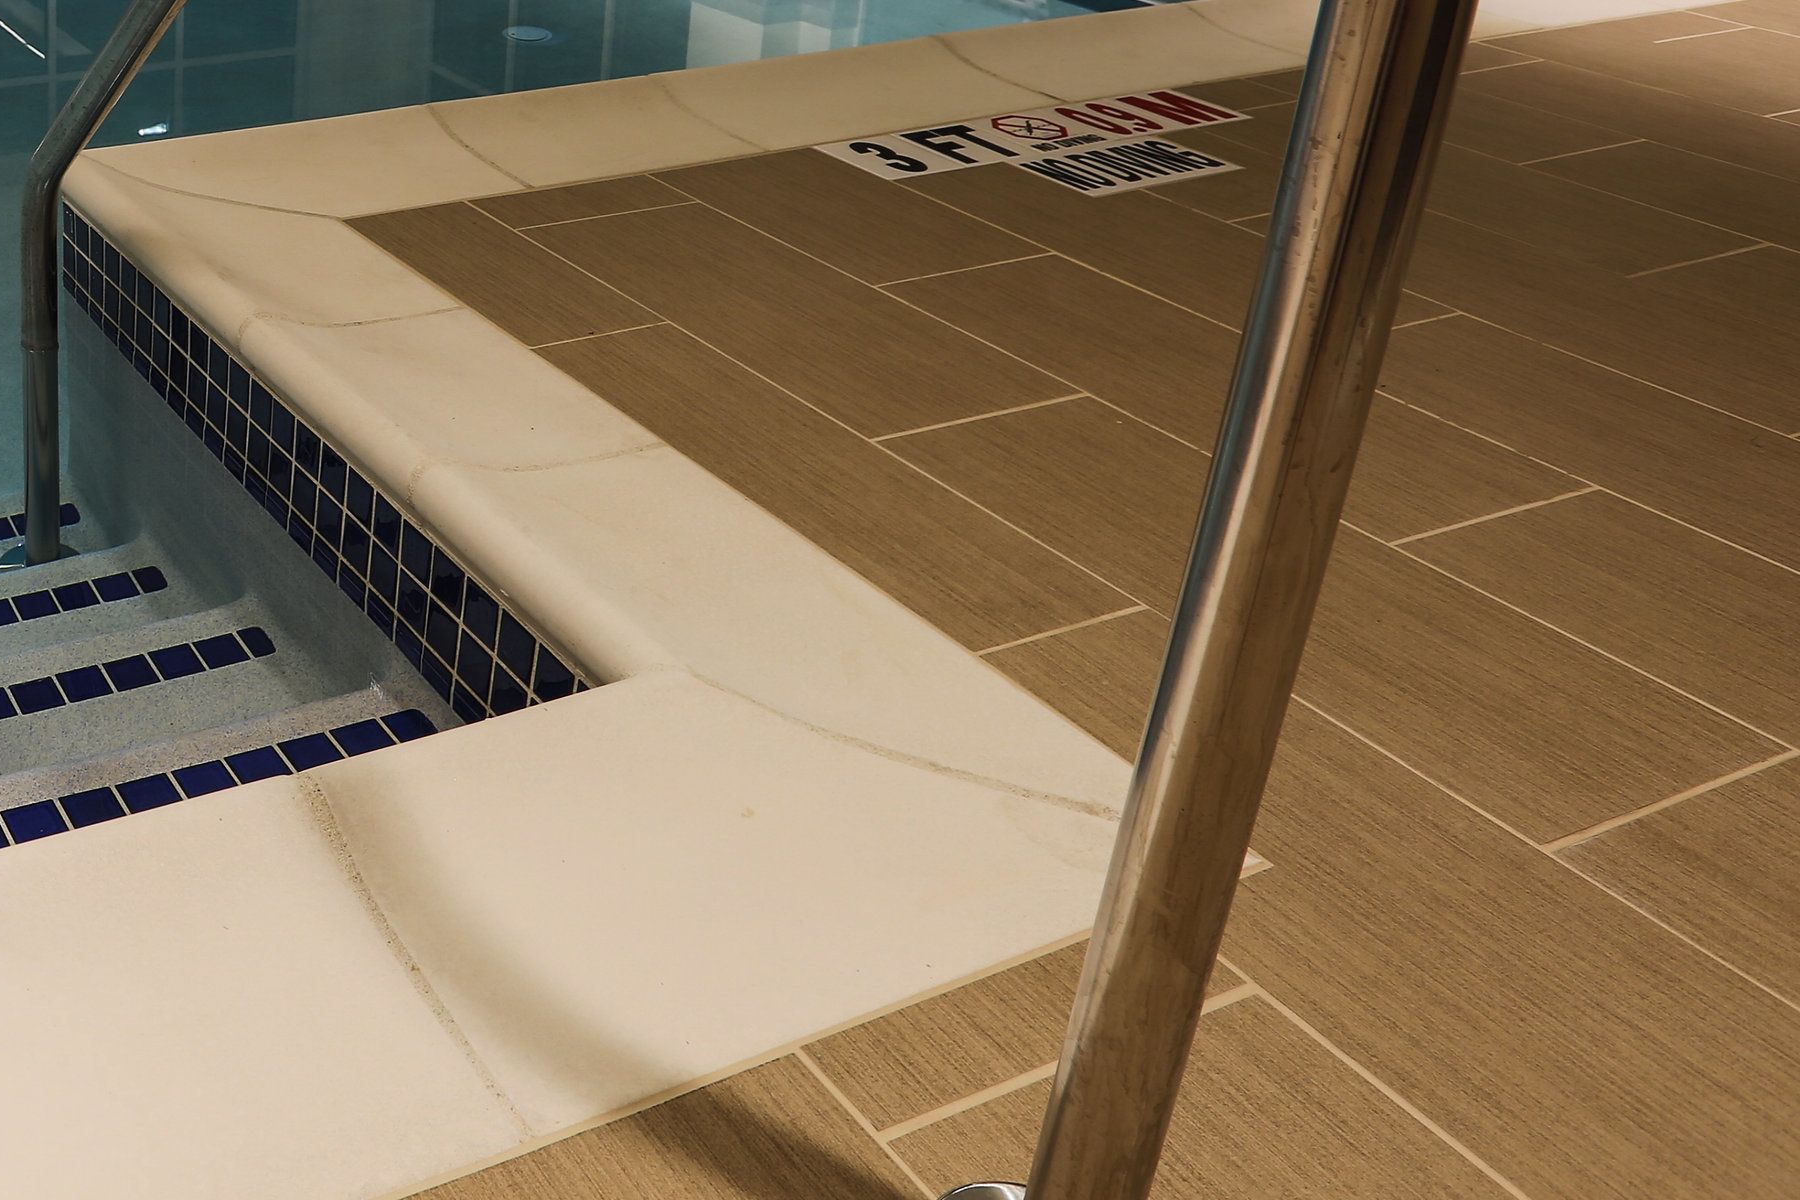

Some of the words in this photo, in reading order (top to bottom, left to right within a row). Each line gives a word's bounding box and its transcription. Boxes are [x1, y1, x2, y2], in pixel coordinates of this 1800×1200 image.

[849, 141, 928, 173] 3
[899, 124, 1020, 164] FT
[1115, 90, 1239, 126] M
[1019, 158, 1117, 191] NO
[1063, 140, 1227, 183] DIVING
